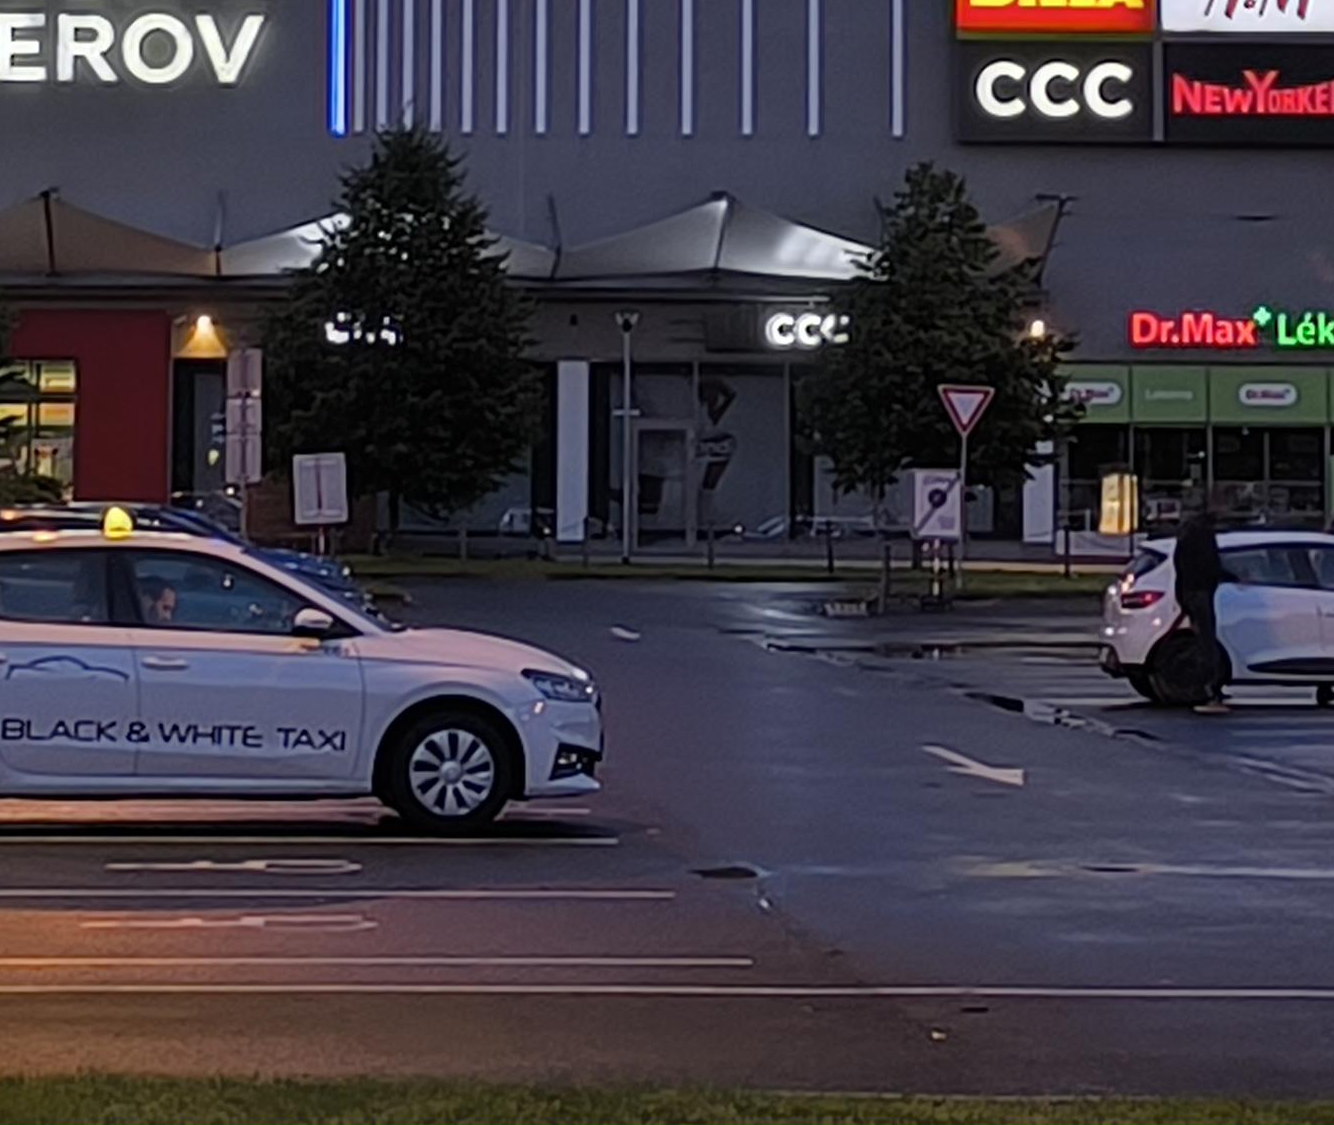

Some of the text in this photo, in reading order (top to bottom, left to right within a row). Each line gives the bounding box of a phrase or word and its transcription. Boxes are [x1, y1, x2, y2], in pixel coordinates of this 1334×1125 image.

[974, 59, 1134, 117] CCC
[1130, 312, 1257, 346] Dr.Max
[0, 718, 348, 751] BLACK & WHITE TAXI
